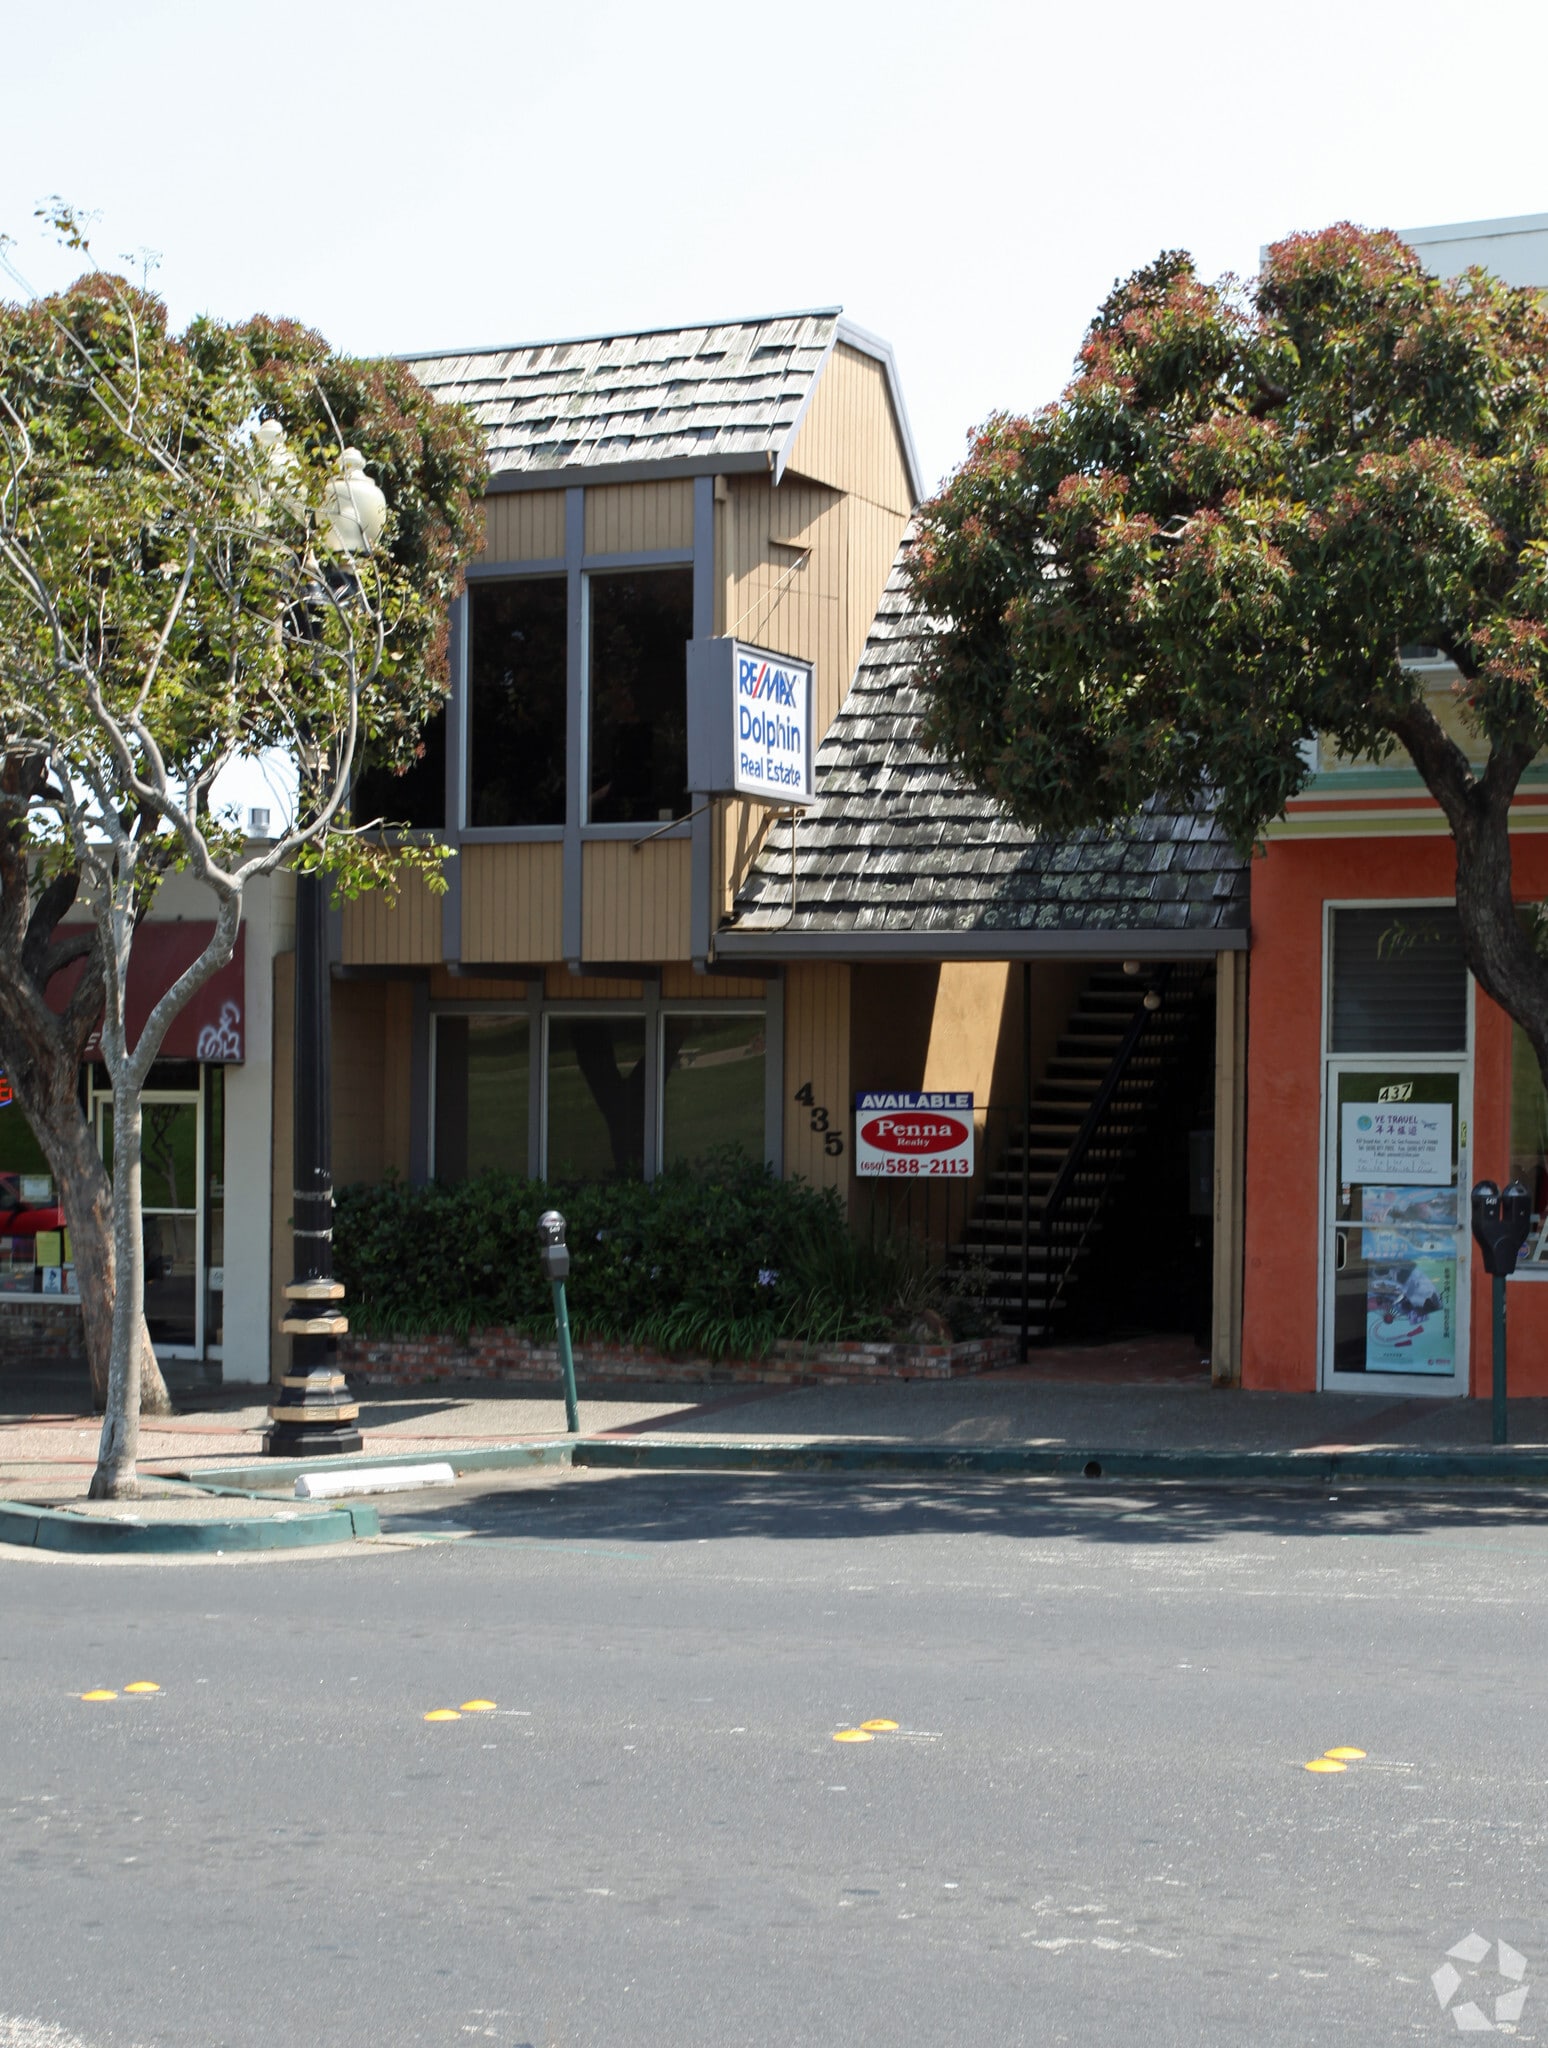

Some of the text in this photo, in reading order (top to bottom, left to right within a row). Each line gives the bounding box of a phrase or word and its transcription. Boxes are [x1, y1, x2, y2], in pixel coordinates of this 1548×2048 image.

[739, 658, 798, 709] RE/MAX
[739, 705, 801, 754] Dolphin
[740, 751, 800, 786] Real Estate
[1380, 1084, 1411, 1101] 437
[860, 1094, 970, 1109] AVAILABLE
[876, 1119, 953, 1137] Penna
[1387, 1115, 1418, 1125] TRAVEL
[897, 1137, 931, 1148] Realty
[886, 1158, 969, 1175] 588-2113
